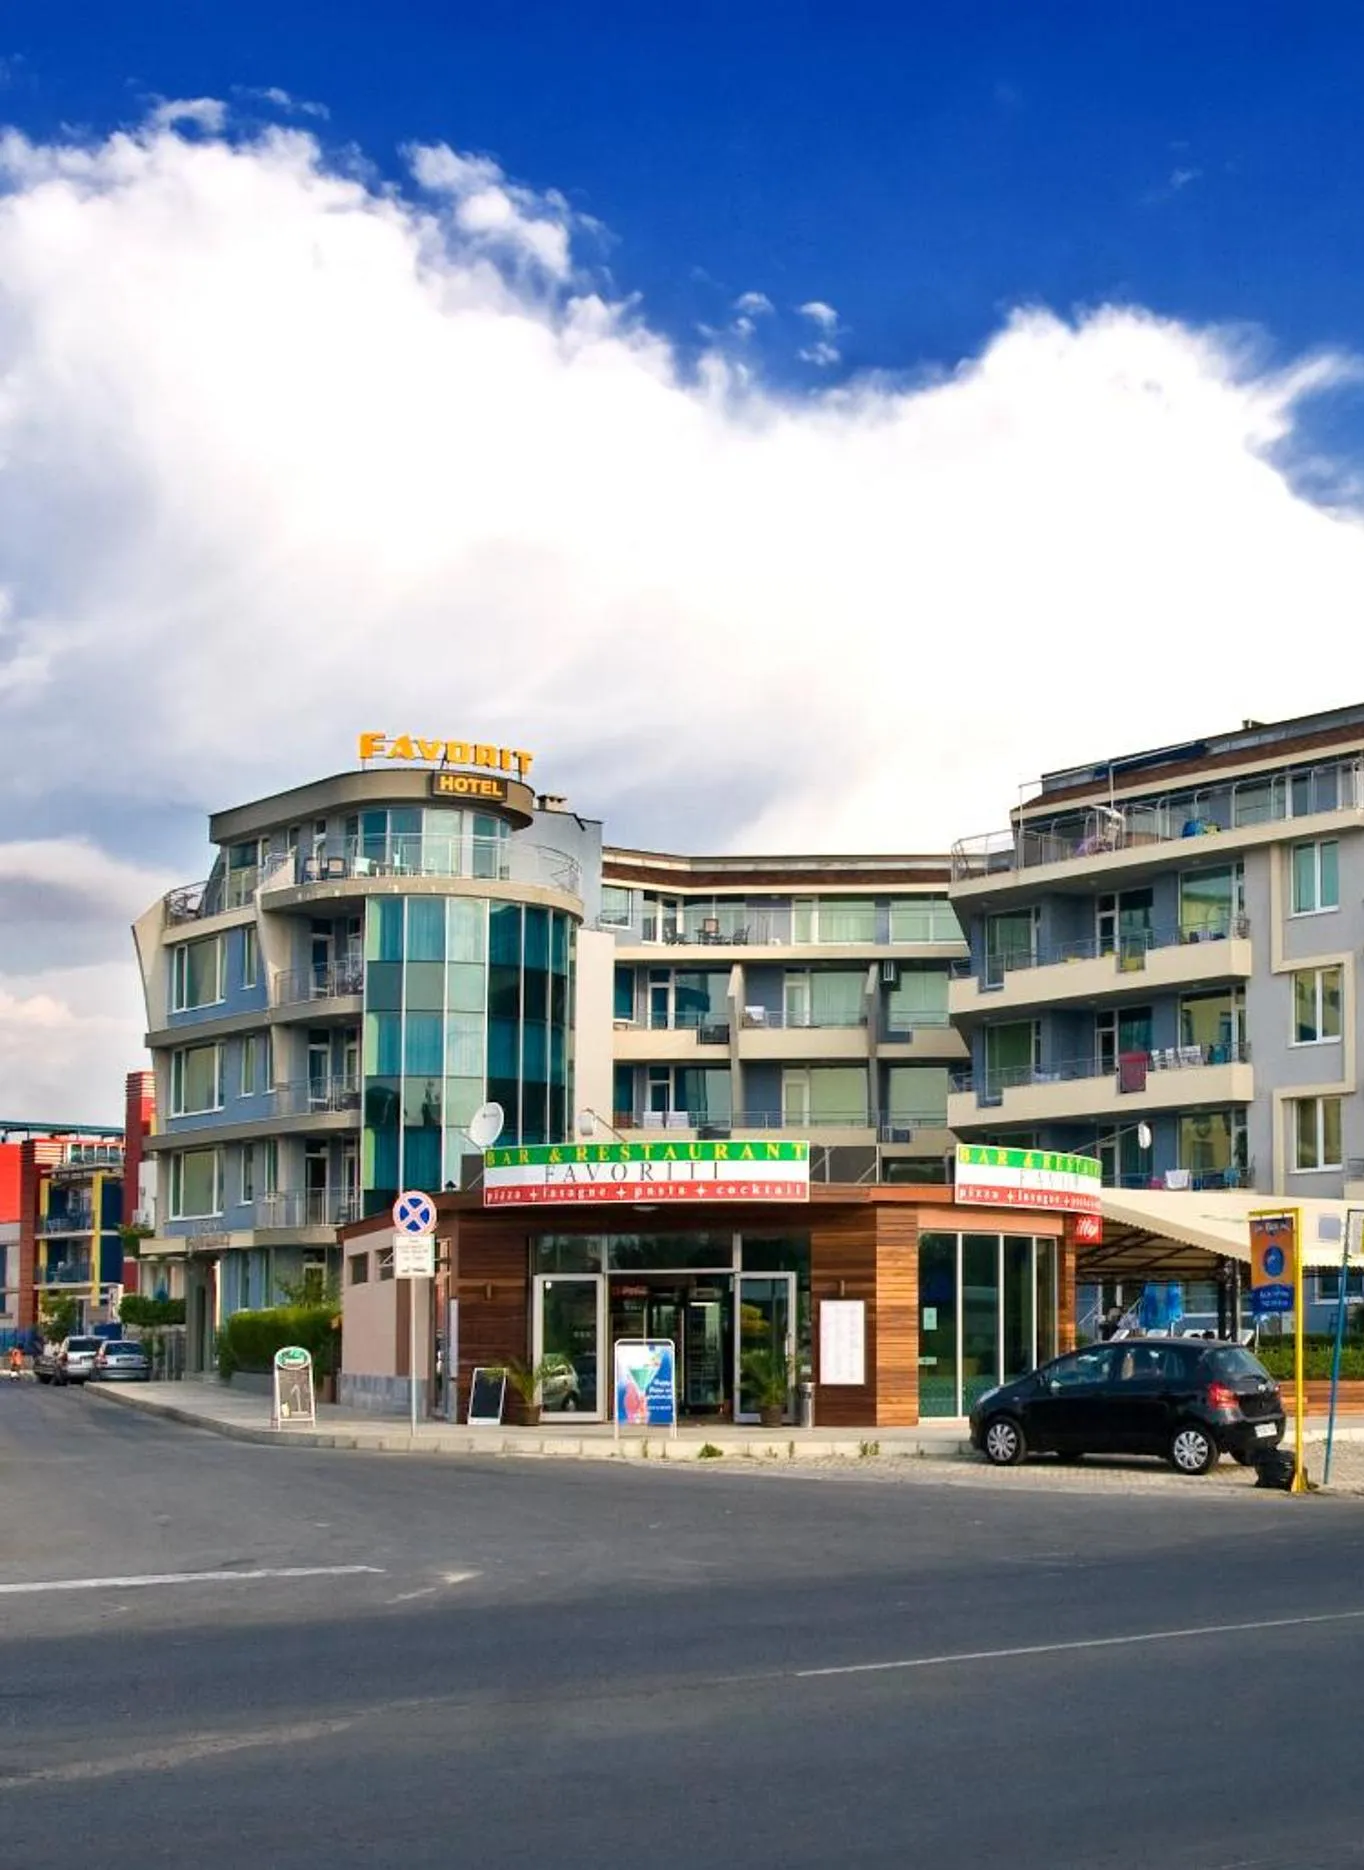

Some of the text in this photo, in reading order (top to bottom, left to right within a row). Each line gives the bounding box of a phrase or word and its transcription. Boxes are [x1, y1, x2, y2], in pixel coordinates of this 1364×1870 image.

[358, 731, 534, 774] FAVORIT
[439, 776, 503, 796] HOTEL
[486, 1143, 806, 1167] BAR & RESTAURANT
[960, 1146, 1007, 1167] BAR
[487, 1189, 521, 1204] pizza
[715, 1183, 802, 1196] cocktail
